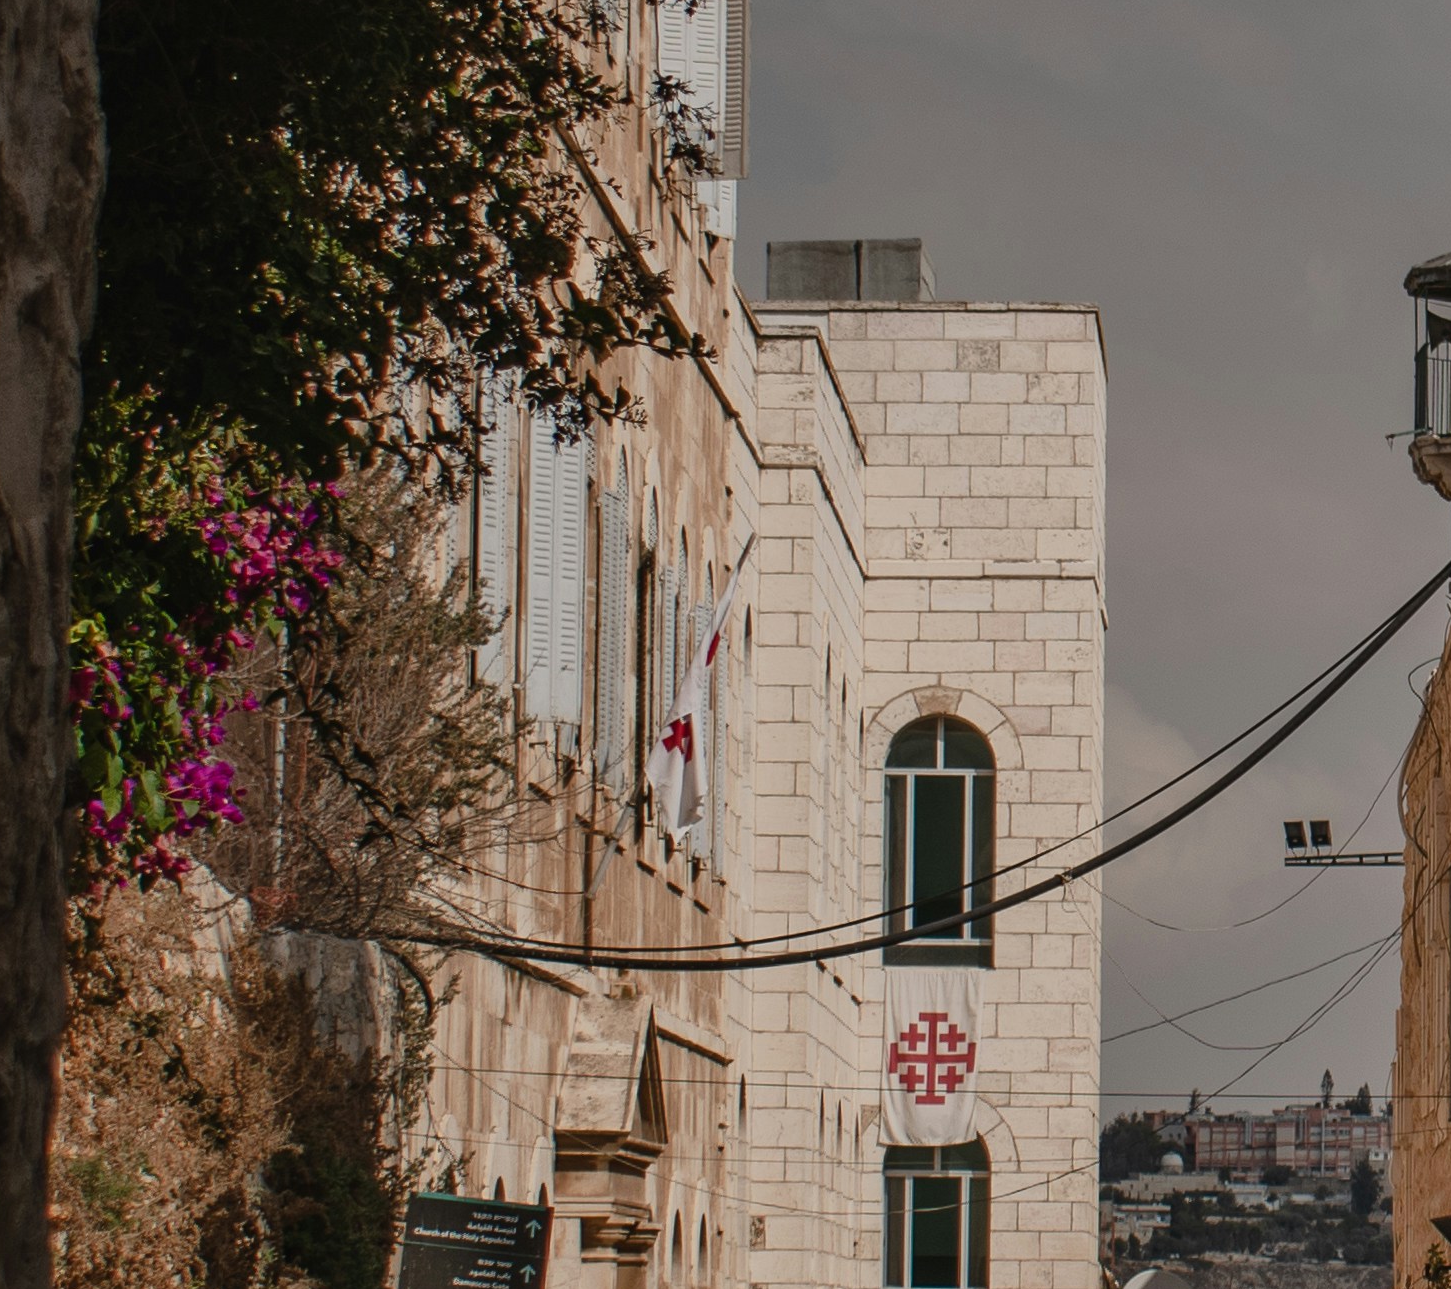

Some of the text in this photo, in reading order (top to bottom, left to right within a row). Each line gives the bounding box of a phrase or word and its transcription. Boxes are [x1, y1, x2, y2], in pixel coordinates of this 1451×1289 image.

[413, 1226, 441, 1237] Church
[449, 1231, 462, 1240] the
[462, 1233, 479, 1243] Holy
